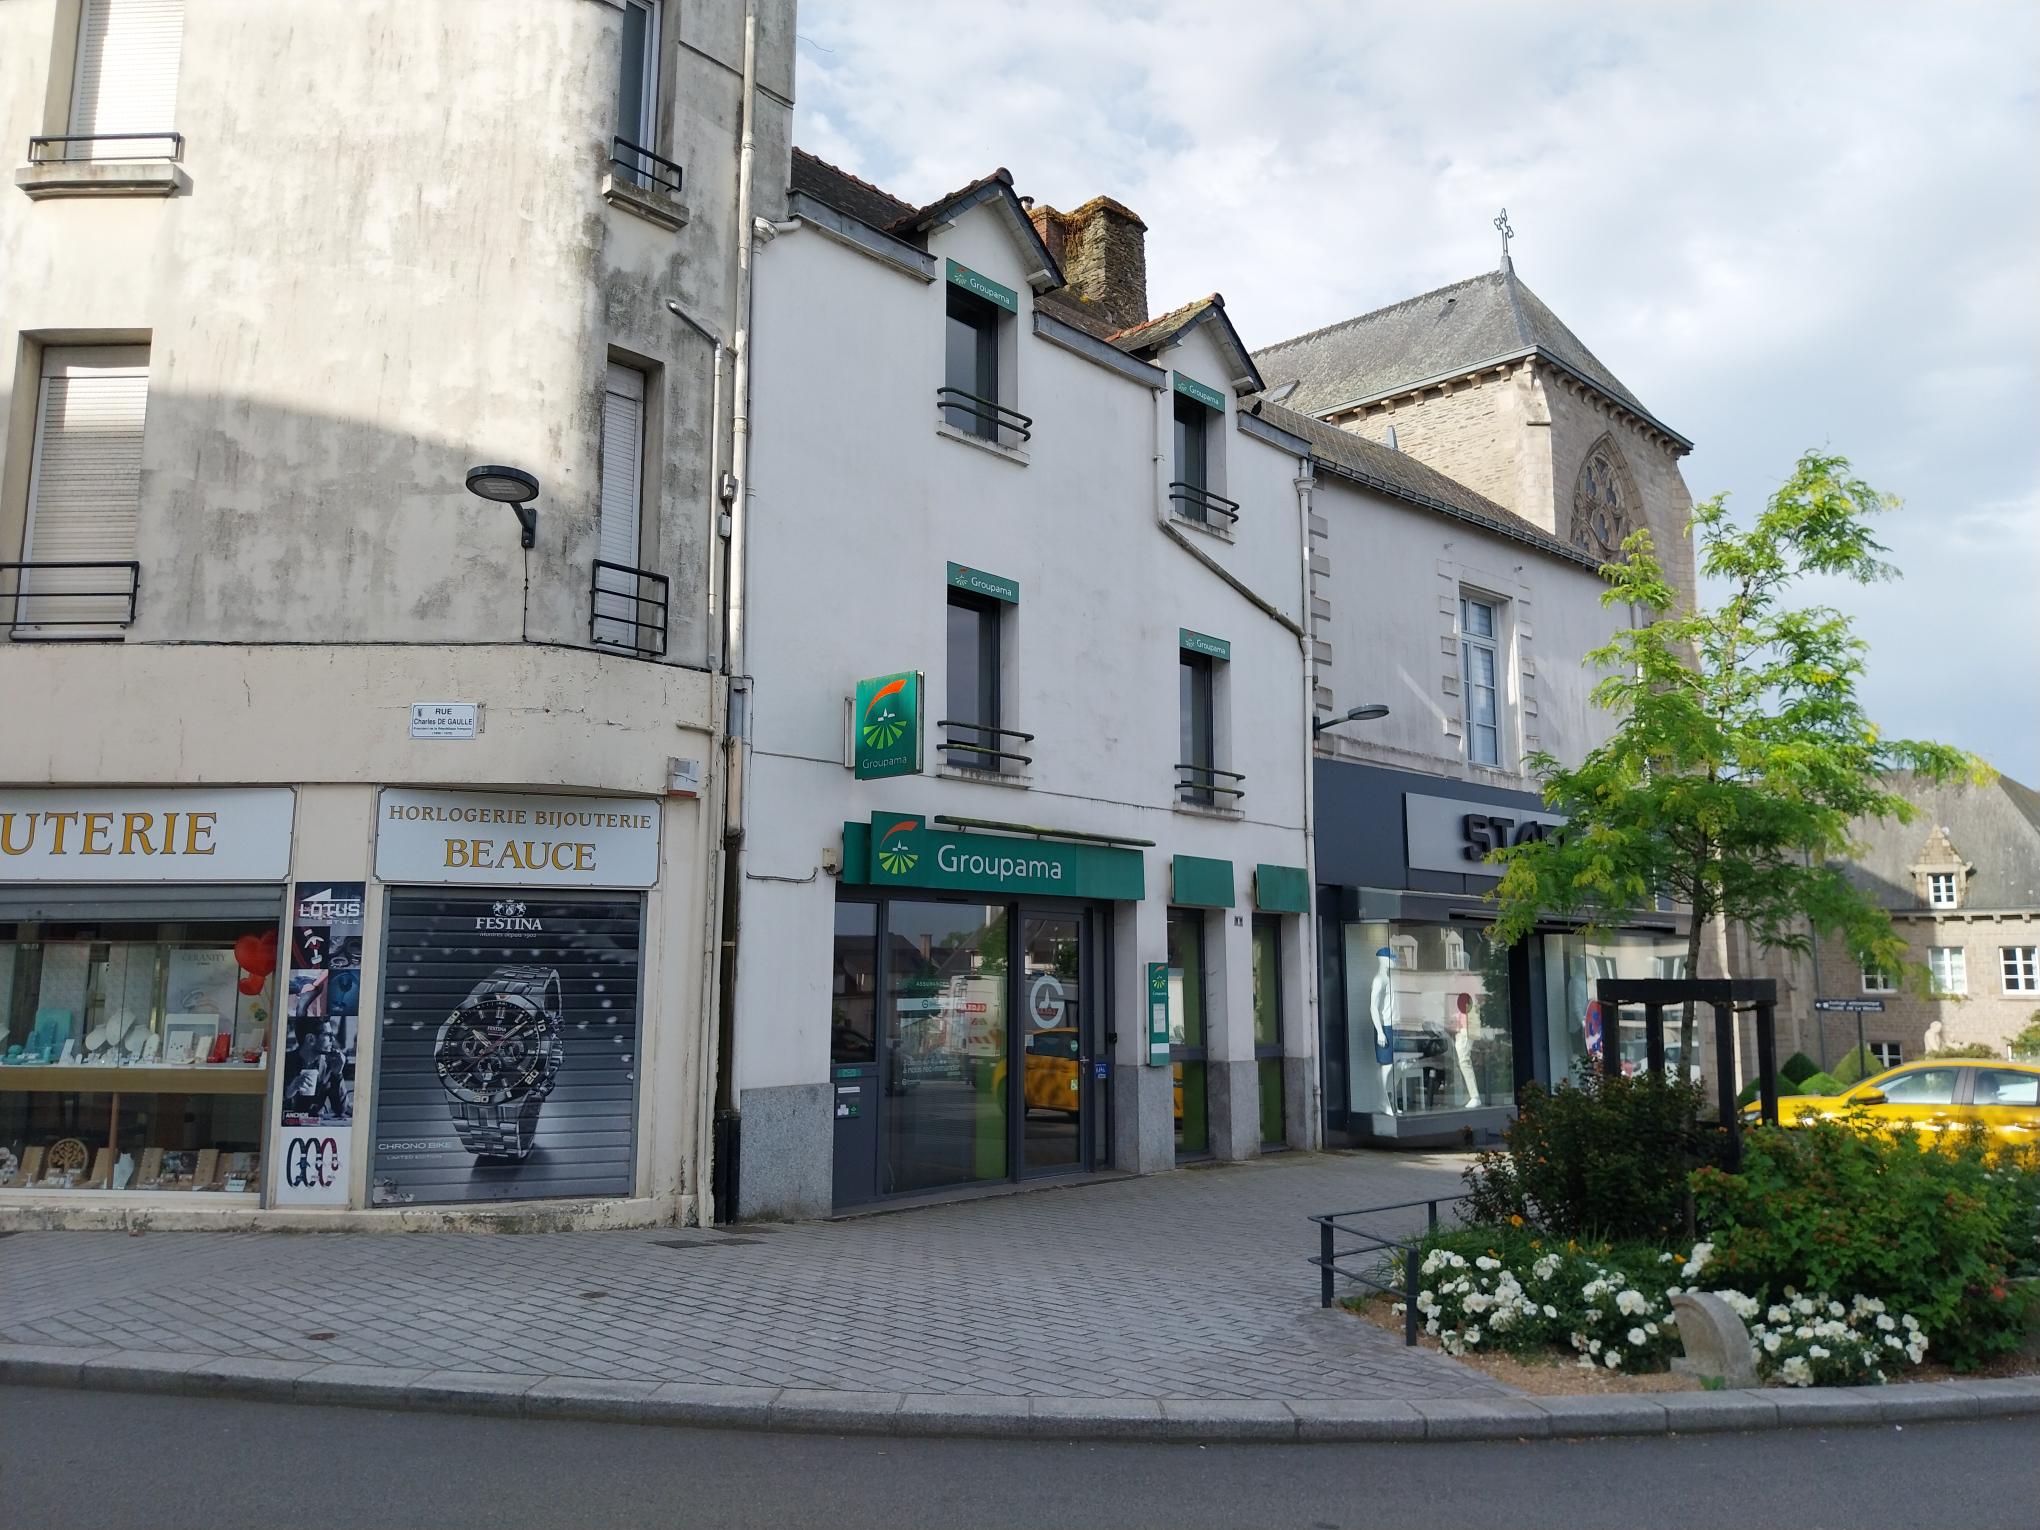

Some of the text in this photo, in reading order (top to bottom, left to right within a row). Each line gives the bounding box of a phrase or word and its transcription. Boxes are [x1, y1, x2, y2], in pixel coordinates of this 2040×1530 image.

[969, 278, 1010, 305] Groupama
[1189, 384, 1219, 405] Groupama
[971, 576, 1012, 597] Groupama
[1196, 639, 1226, 655] Groupama
[447, 718, 473, 726] GAULLE
[862, 756, 907, 769] Groupama
[388, 805, 652, 830] HORLOGERIE BIJOUTERIE
[0, 811, 217, 855] UTERIE
[443, 838, 597, 872] BEAUCE
[936, 844, 1063, 882] Groupama
[298, 903, 361, 917] LOTUS
[475, 917, 543, 931] FESTINA
[378, 1142, 427, 1150] CHRONO
